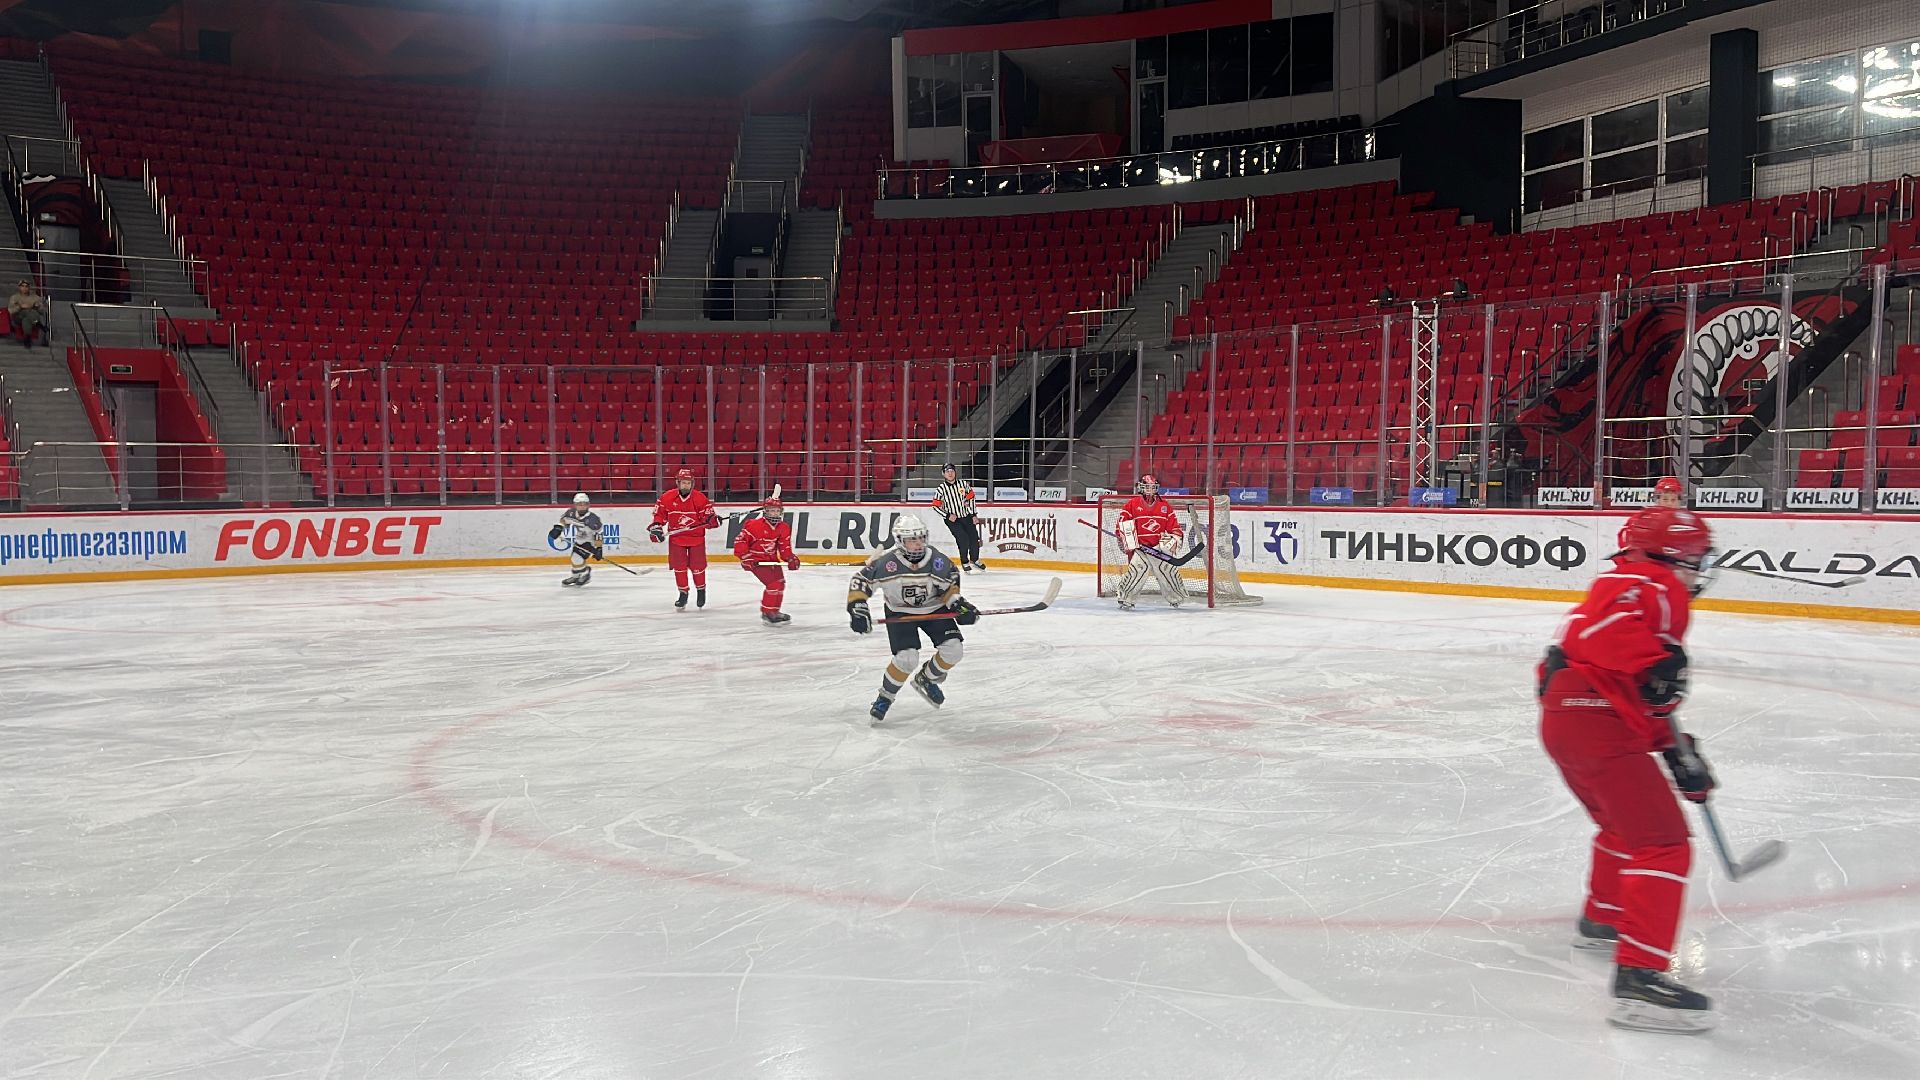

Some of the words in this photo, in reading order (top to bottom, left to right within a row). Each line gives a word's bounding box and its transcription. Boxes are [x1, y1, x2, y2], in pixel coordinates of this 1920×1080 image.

[1541, 491, 1590, 502] KHL.RU
[1614, 491, 1656, 503] KHL.R
[1700, 491, 1759, 504] KHL.RU
[1791, 491, 1854, 505] KHL.RU
[1881, 491, 1919, 505] KHL.
[214, 516, 442, 561] FONBET
[977, 513, 1057, 552] ТУЛЬСКИЙ
[1321, 530, 1587, 571] ТИНЬКОФФ
